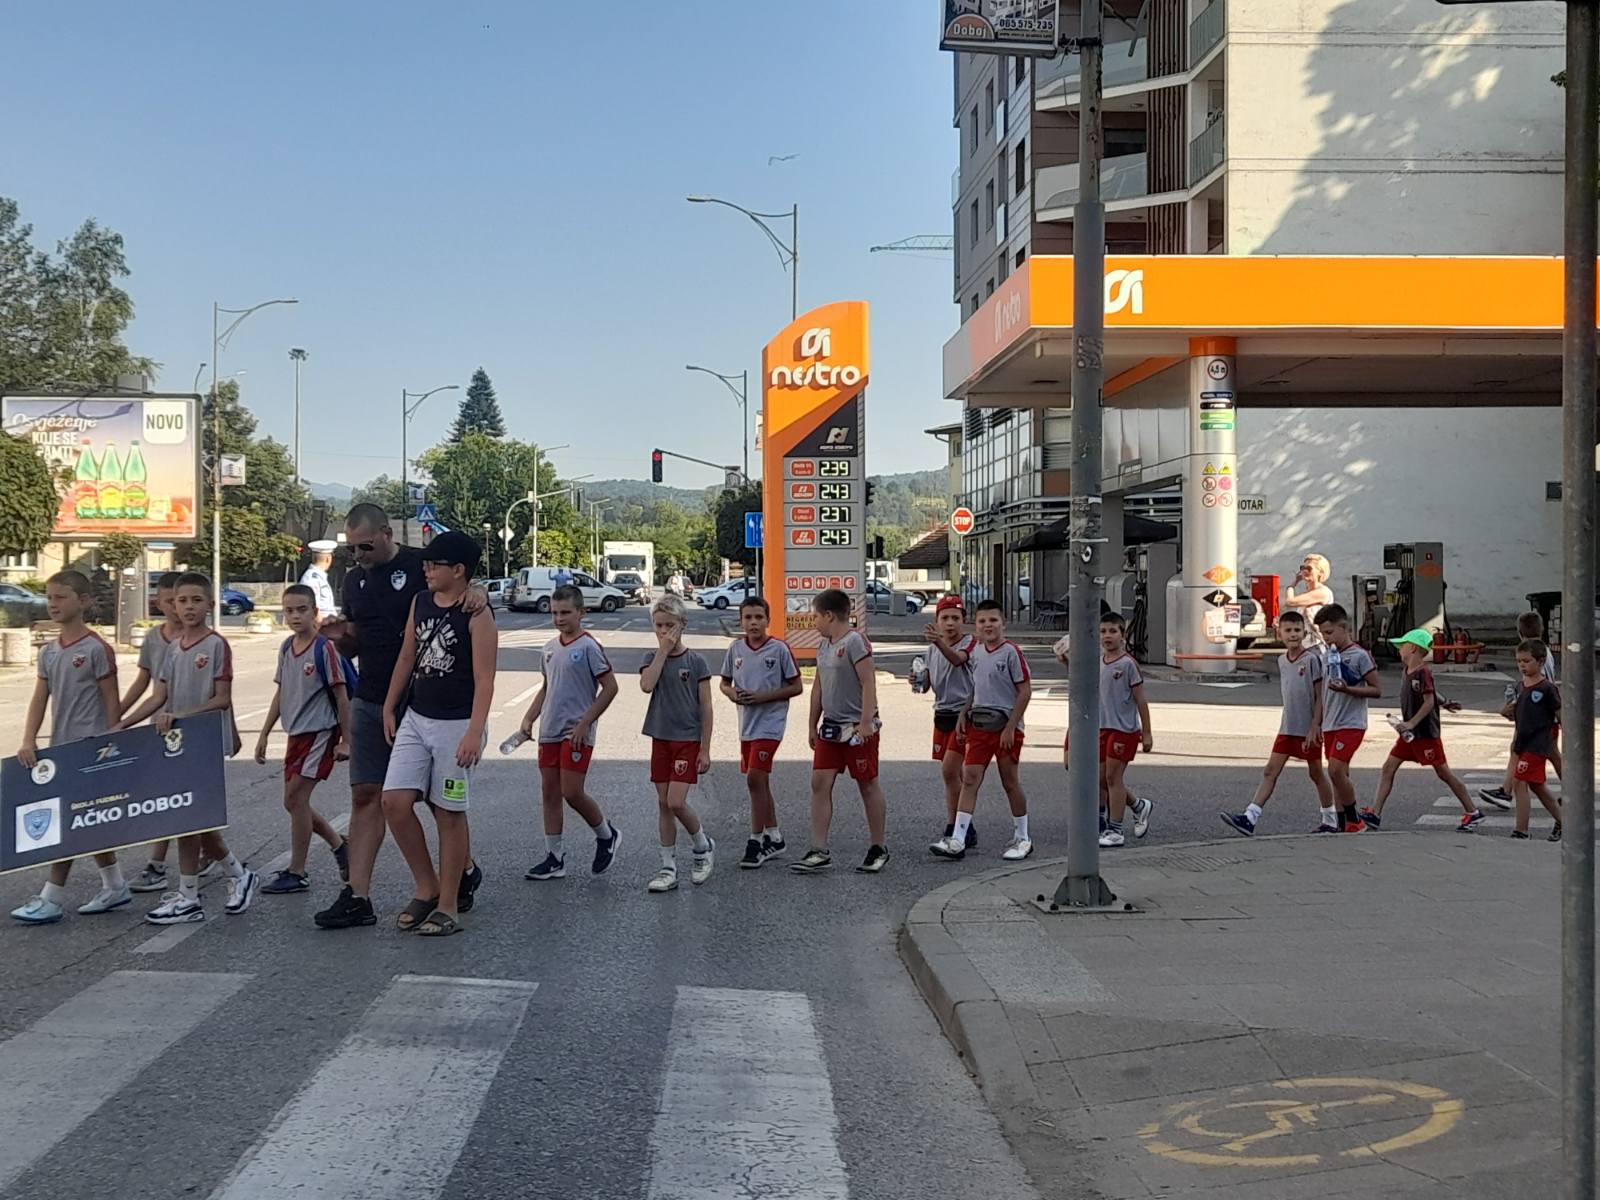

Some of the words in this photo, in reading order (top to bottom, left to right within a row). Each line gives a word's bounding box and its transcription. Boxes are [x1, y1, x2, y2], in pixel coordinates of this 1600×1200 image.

[953, 23, 987, 39] Doboj
[771, 362, 861, 386] nestro
[146, 414, 184, 430] NOVO
[31, 431, 60, 445] KOJE
[62, 431, 78, 445] SE
[954, 516, 970, 526] STOP
[70, 806, 122, 830] AČKO
[127, 792, 193, 817] DOBOJ
